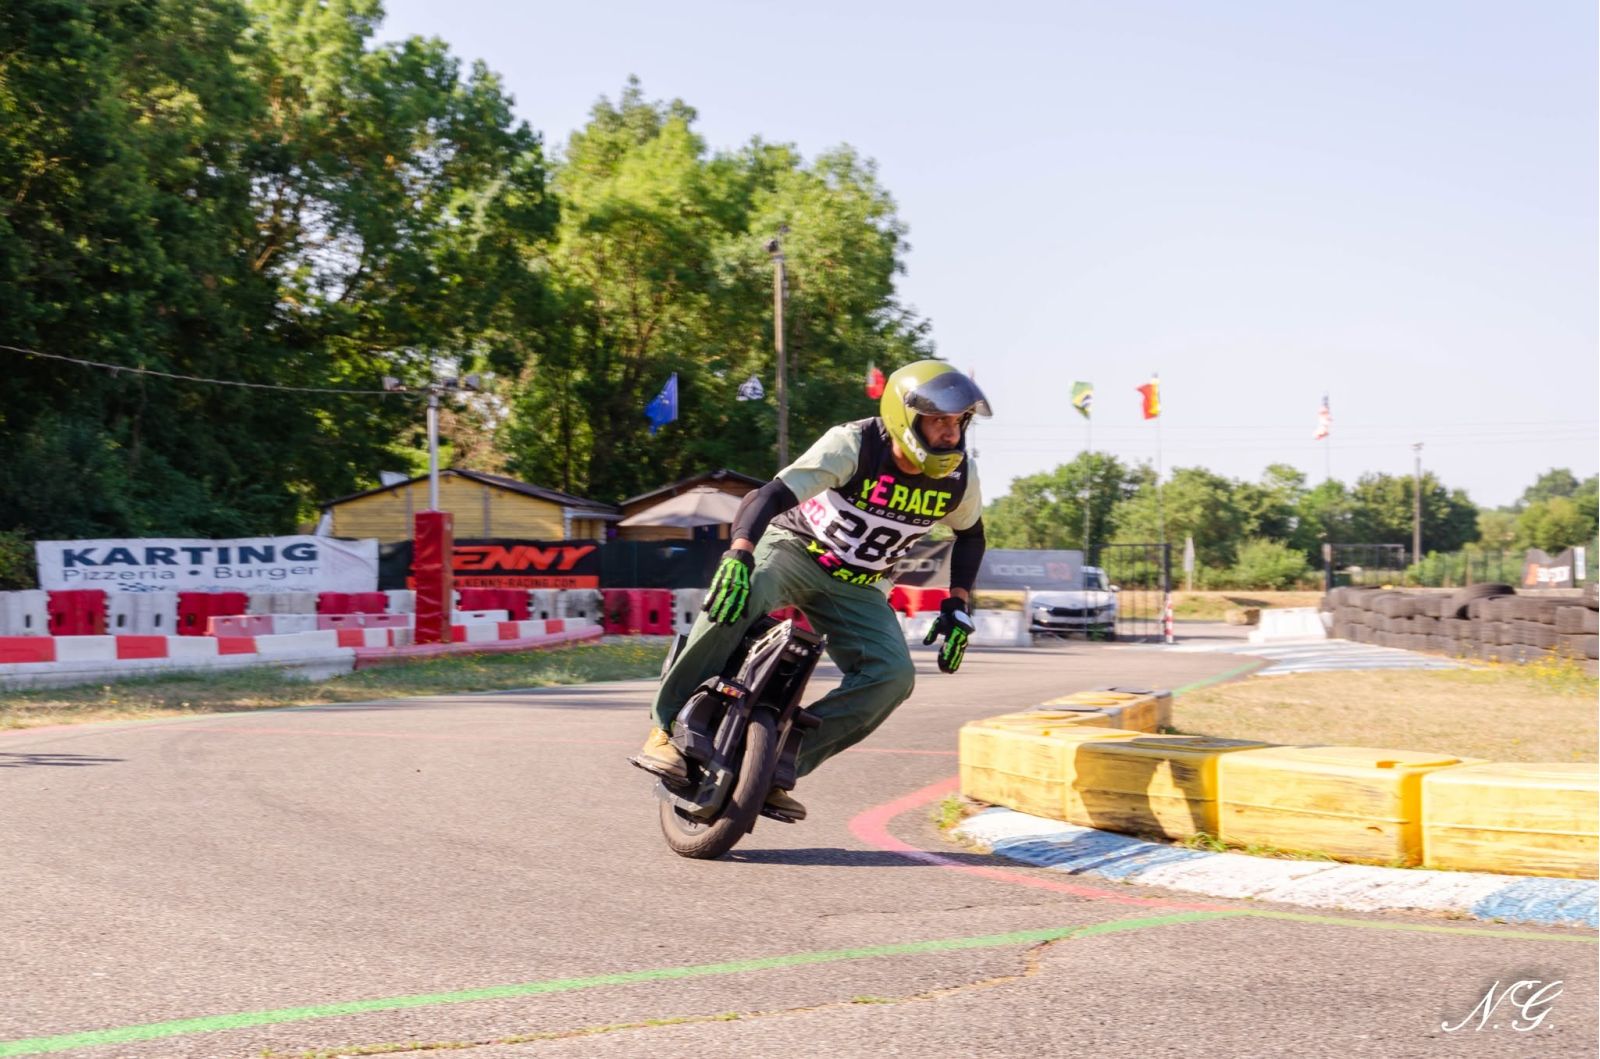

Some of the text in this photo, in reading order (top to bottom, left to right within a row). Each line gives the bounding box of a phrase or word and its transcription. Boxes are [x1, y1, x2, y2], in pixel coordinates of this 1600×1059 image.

[63, 543, 318, 568] KARTING
[453, 545, 597, 571] ENNY
[63, 564, 319, 582] Pizzeria Burger
